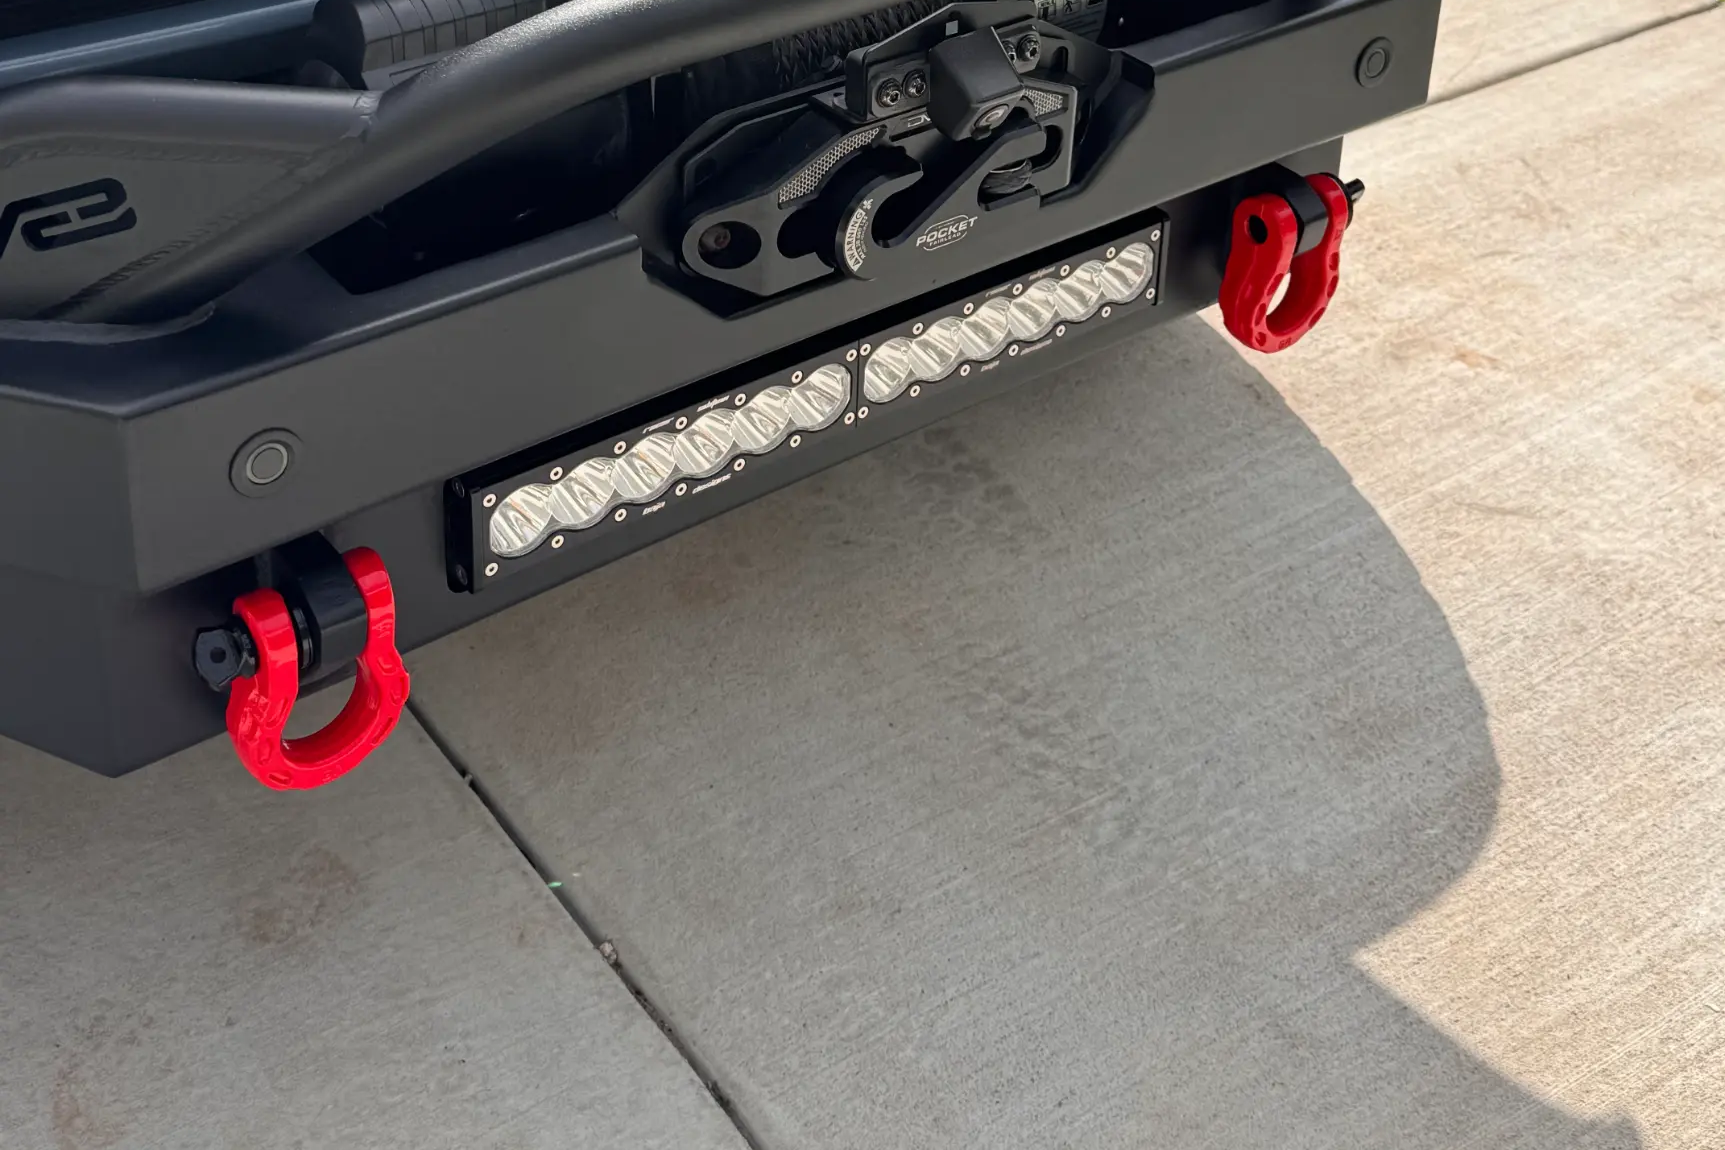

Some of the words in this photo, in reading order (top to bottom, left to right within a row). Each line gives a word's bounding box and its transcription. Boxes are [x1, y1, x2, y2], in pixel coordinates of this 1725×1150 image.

[847, 211, 863, 262] WARNING
[915, 215, 979, 247] POCKET
[929, 231, 962, 247] FAIRLEAD
